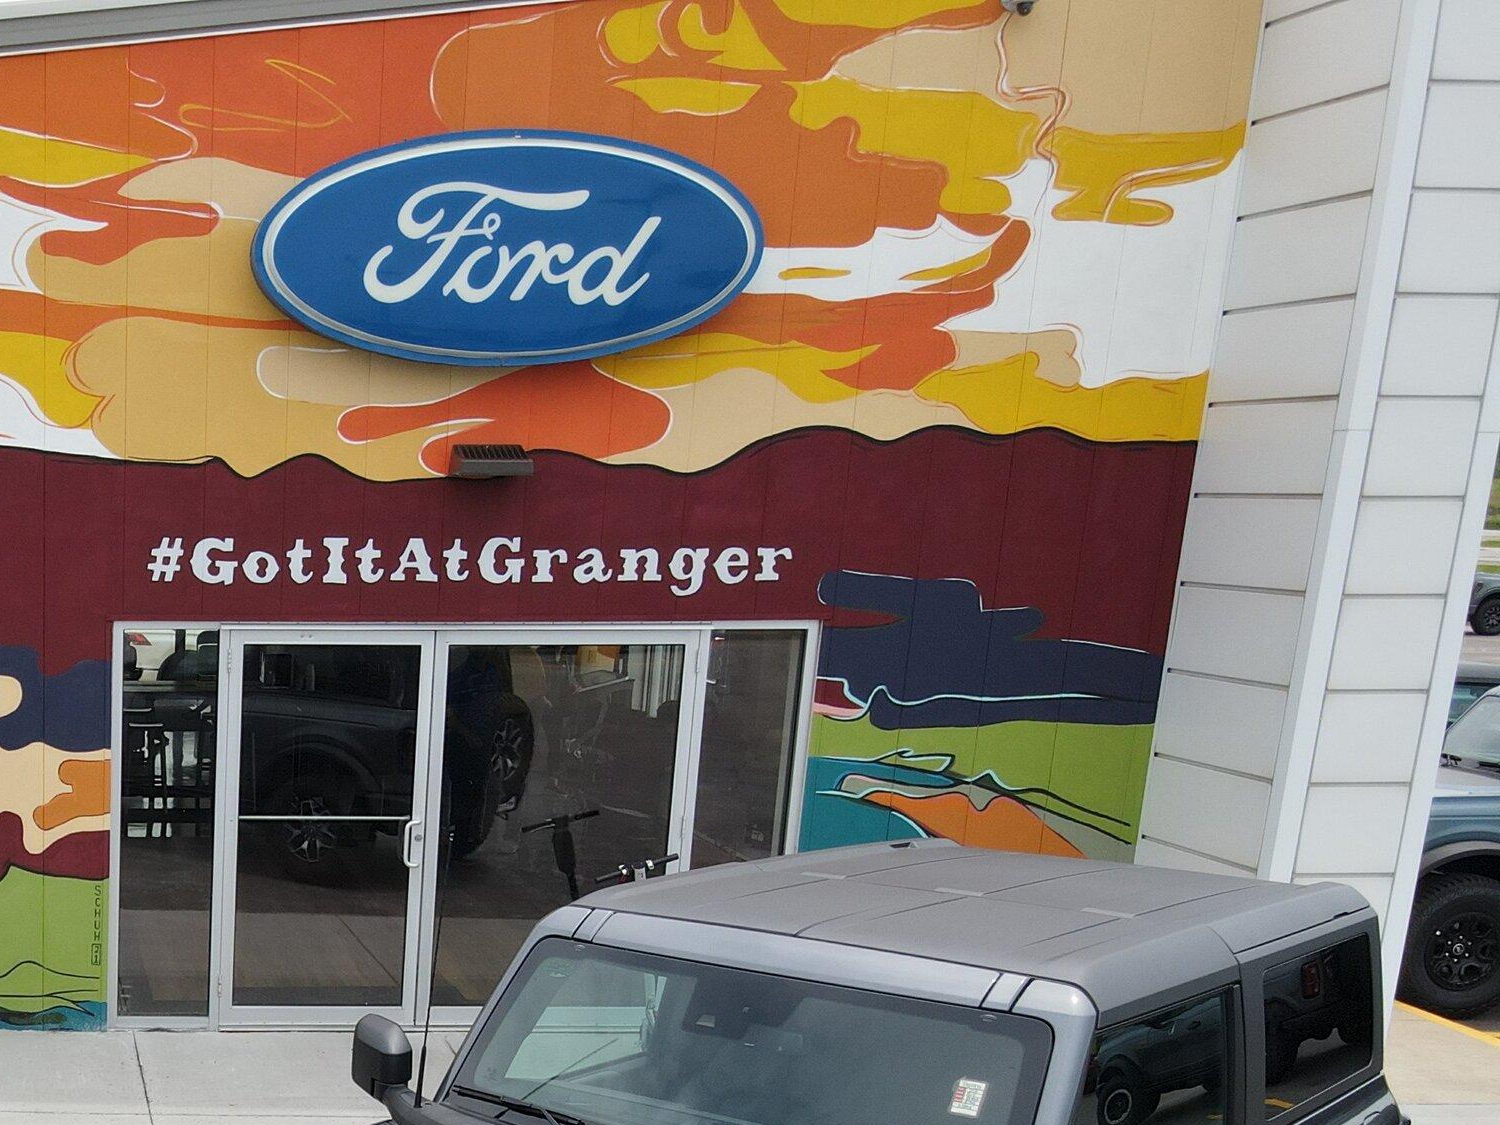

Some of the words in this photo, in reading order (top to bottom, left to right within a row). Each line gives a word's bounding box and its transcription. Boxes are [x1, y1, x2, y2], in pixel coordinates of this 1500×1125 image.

[363, 181, 661, 306] Ford
[147, 536, 793, 597] #GotItAtGranger
[93, 884, 102, 942] SCHUH
